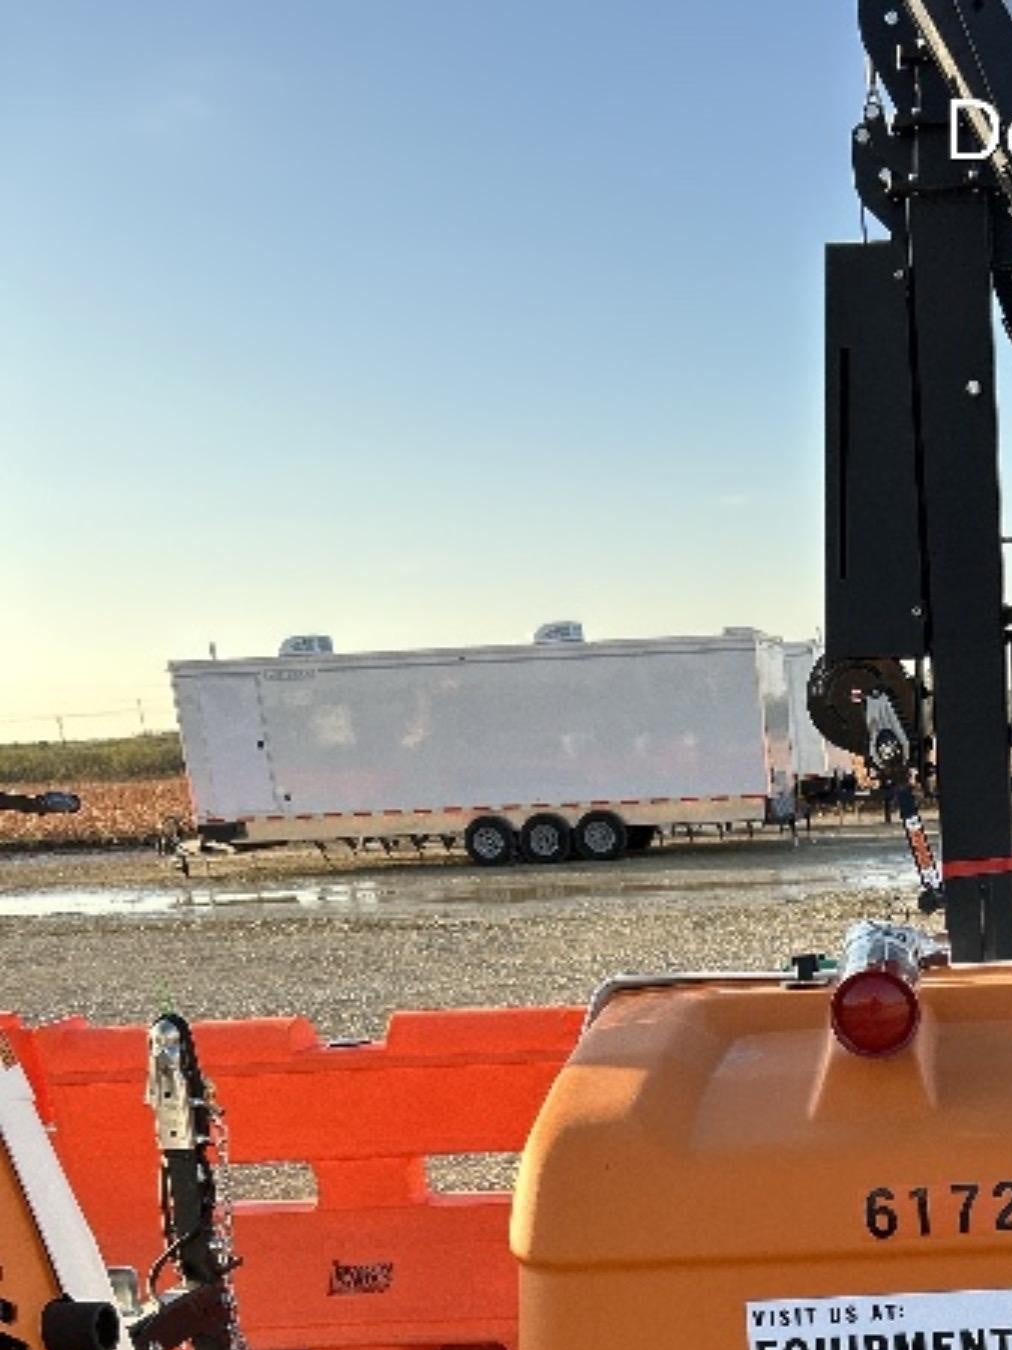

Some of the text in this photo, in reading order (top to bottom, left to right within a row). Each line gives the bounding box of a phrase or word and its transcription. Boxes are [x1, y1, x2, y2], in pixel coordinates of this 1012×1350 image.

[752, 1303, 904, 1327] VISIT US AT:
